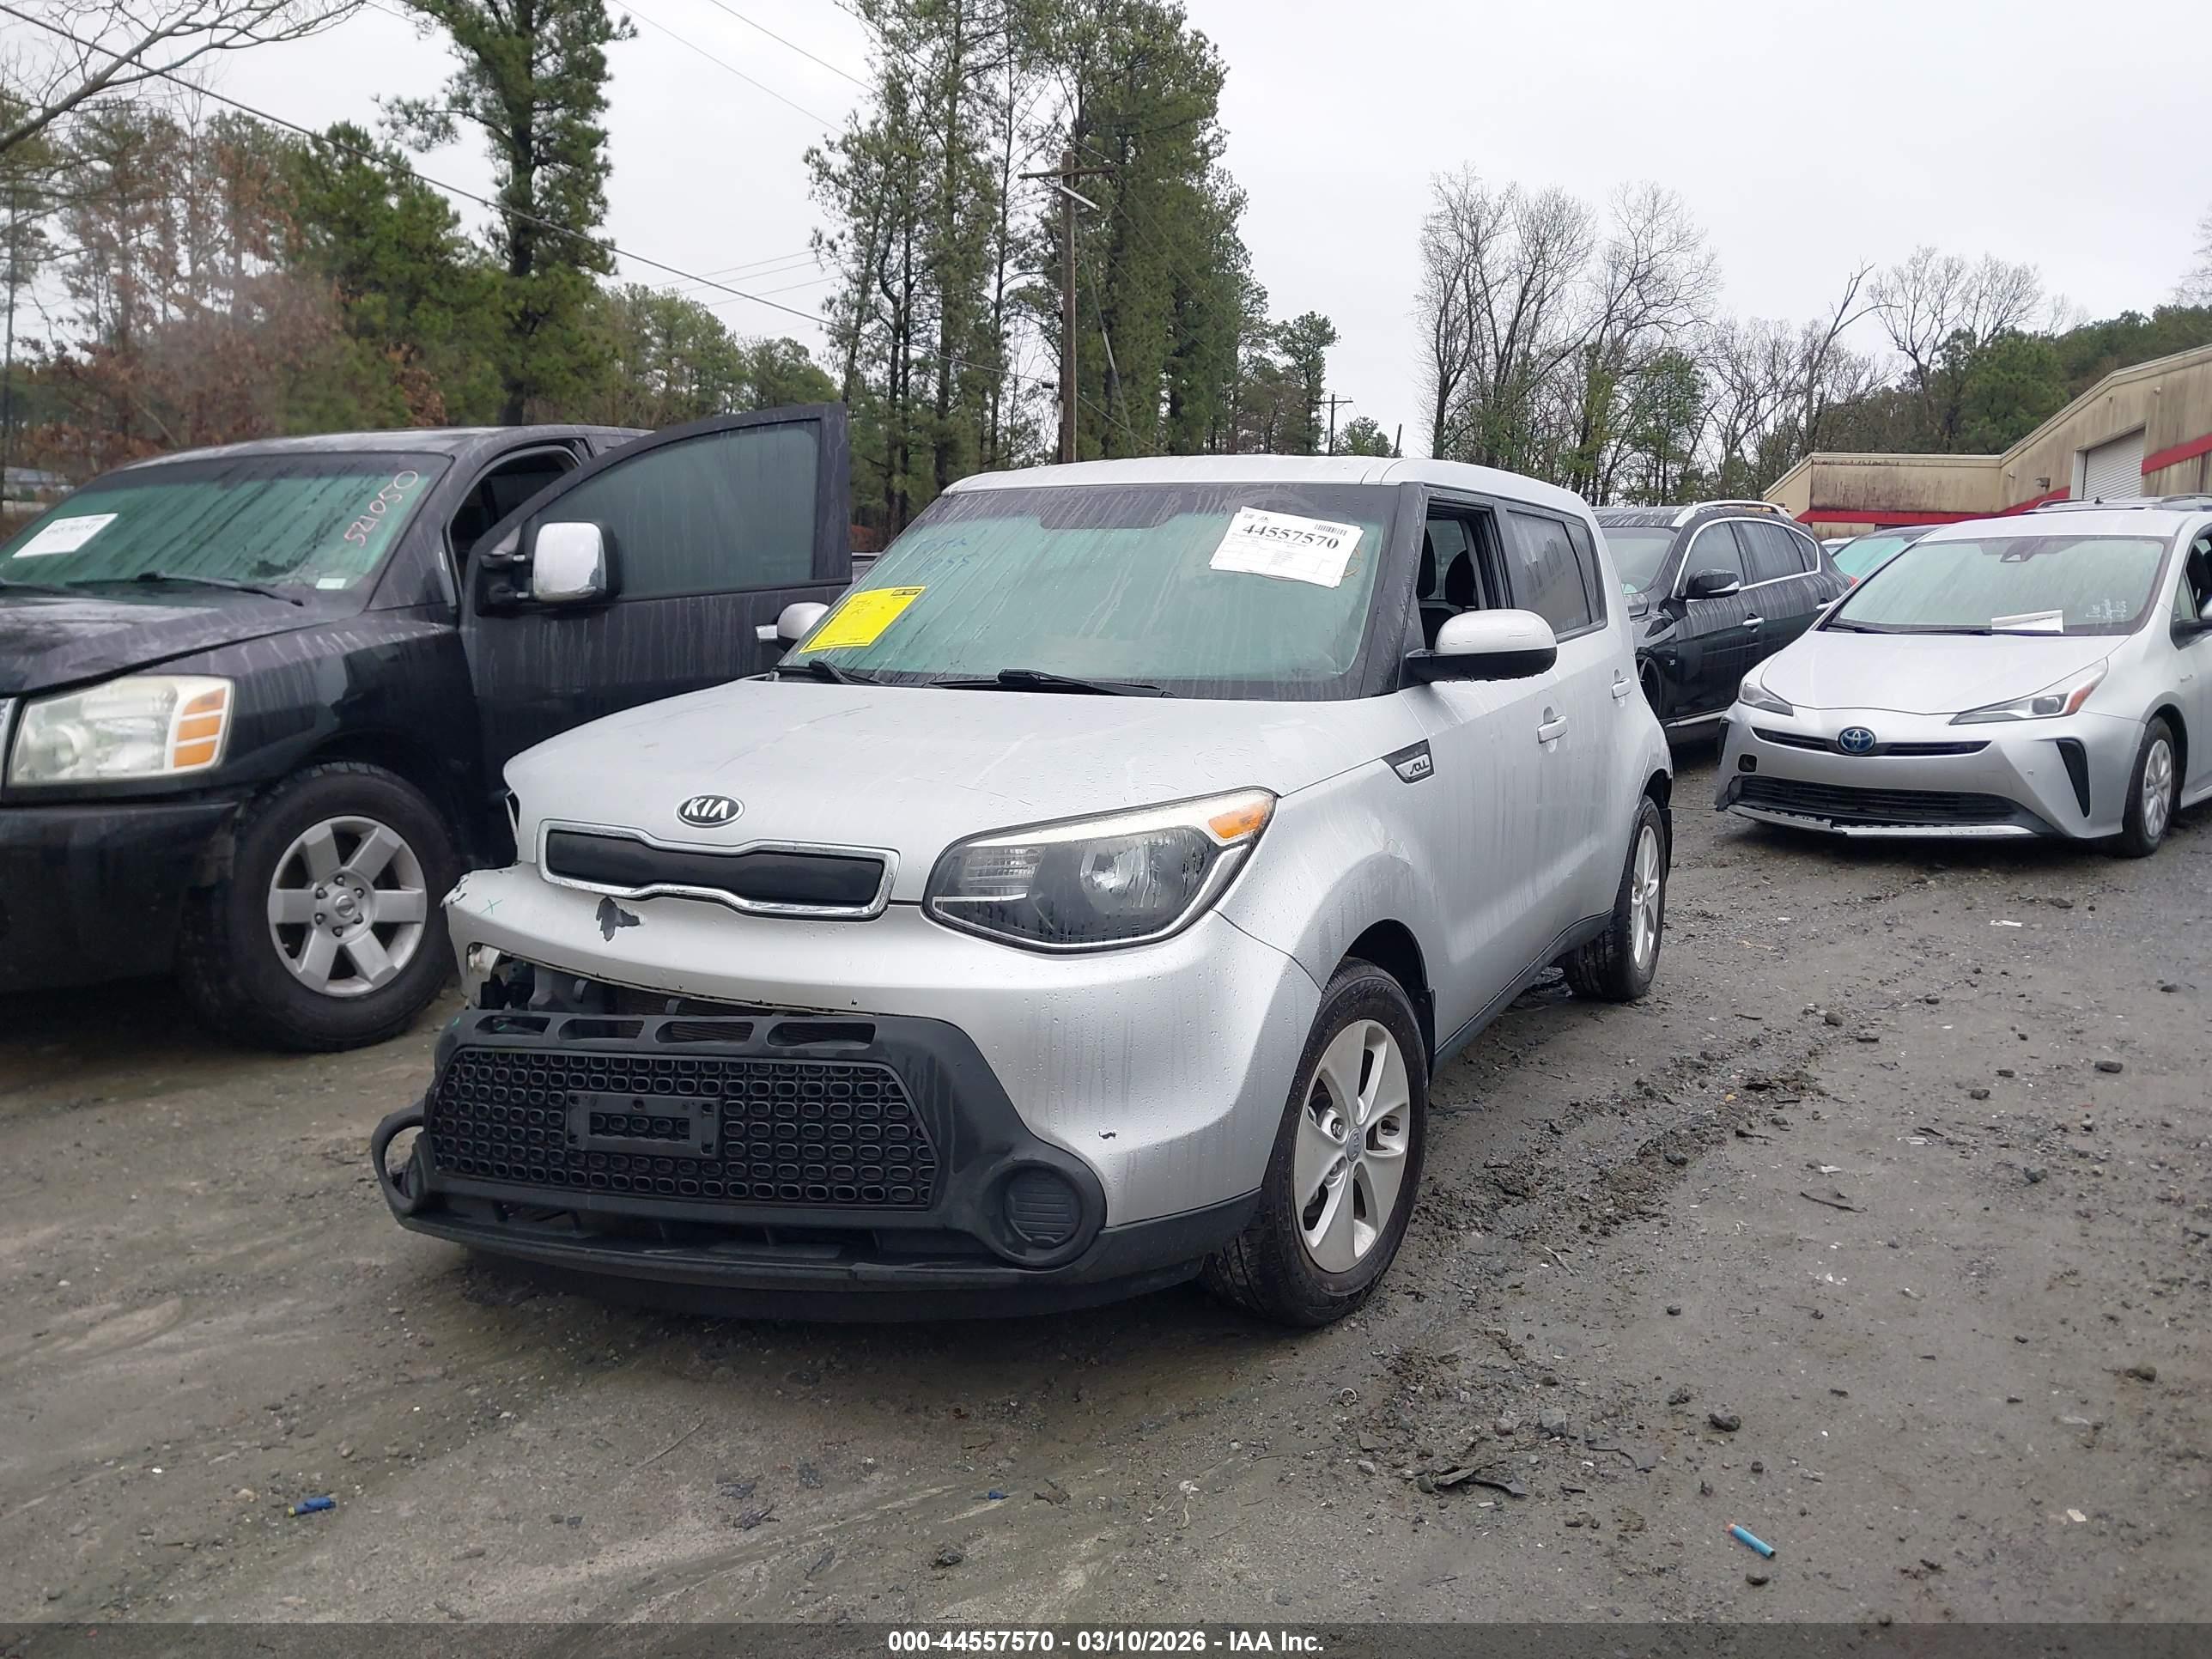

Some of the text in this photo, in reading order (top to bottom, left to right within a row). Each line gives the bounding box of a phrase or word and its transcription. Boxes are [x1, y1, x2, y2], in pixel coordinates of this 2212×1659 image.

[343, 470, 419, 547] 521050
[1243, 524, 1339, 550] 44557570
[684, 798, 729, 819] KIA
